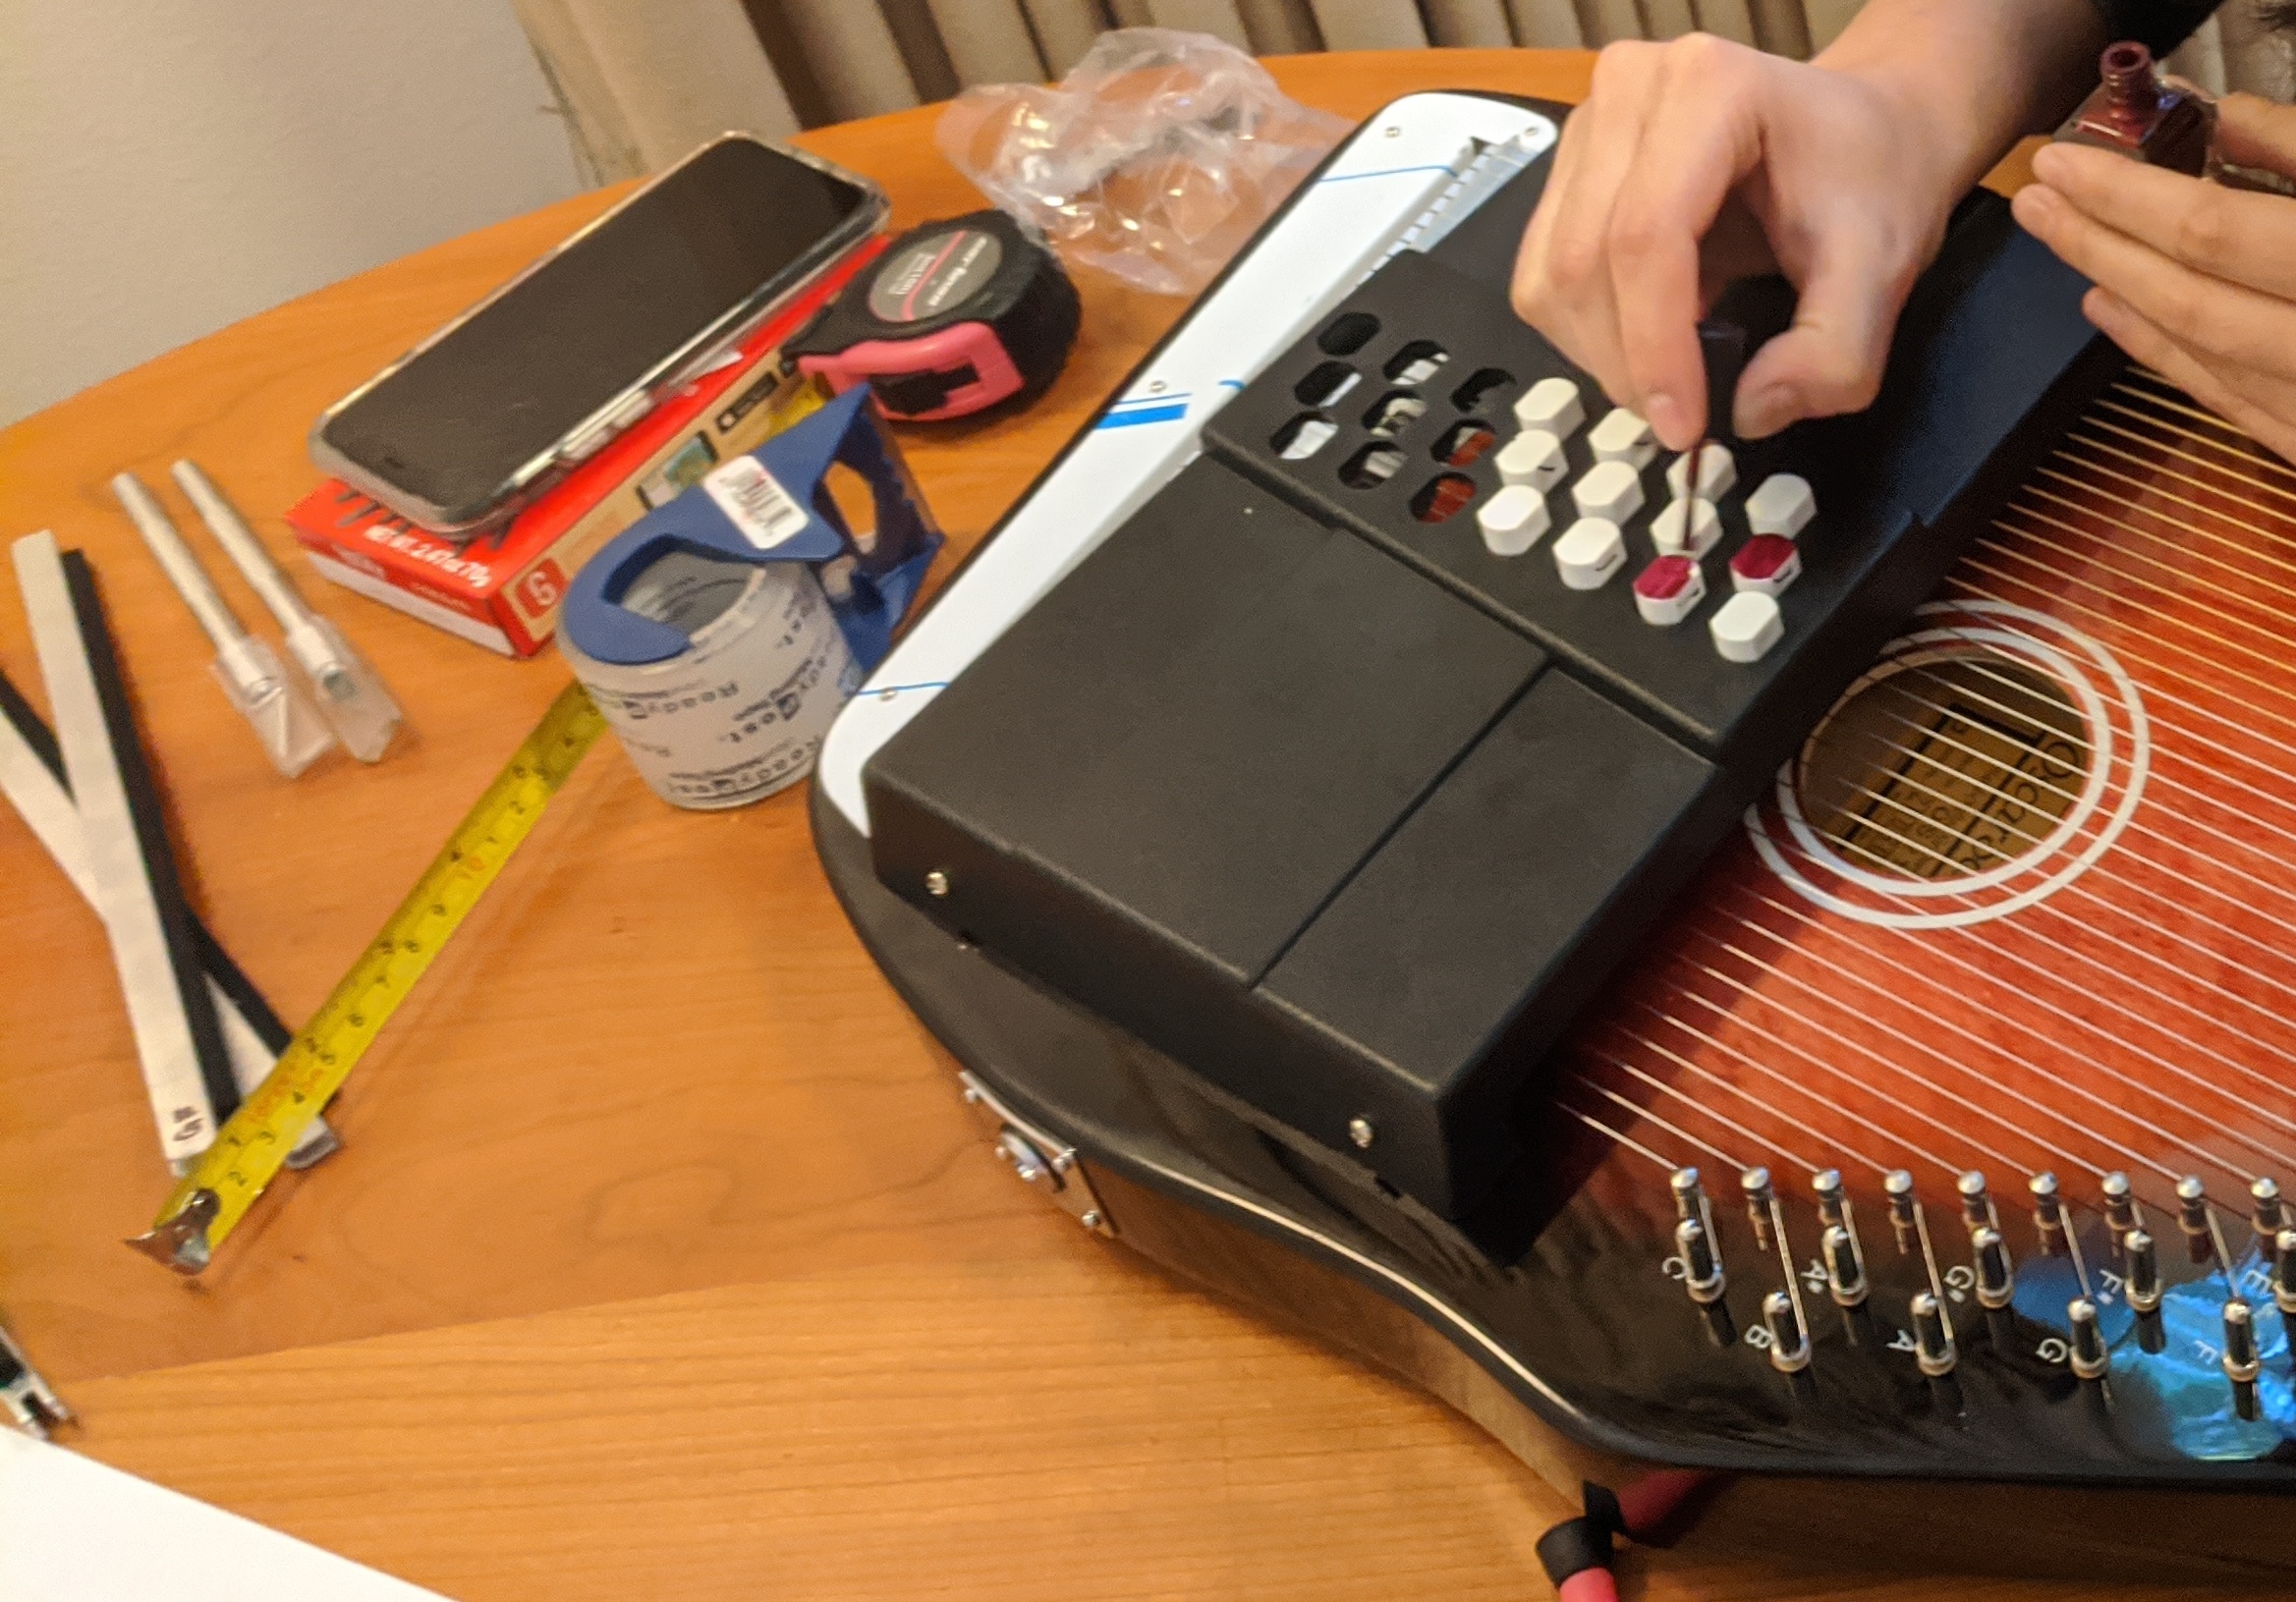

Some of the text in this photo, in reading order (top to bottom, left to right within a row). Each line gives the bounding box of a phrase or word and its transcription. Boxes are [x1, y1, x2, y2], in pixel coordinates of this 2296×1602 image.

[1744, 1323, 1772, 1350] B
[1885, 1328, 1918, 1353] A
[2035, 1337, 2069, 1363] G
[2193, 1339, 2219, 1366] F
